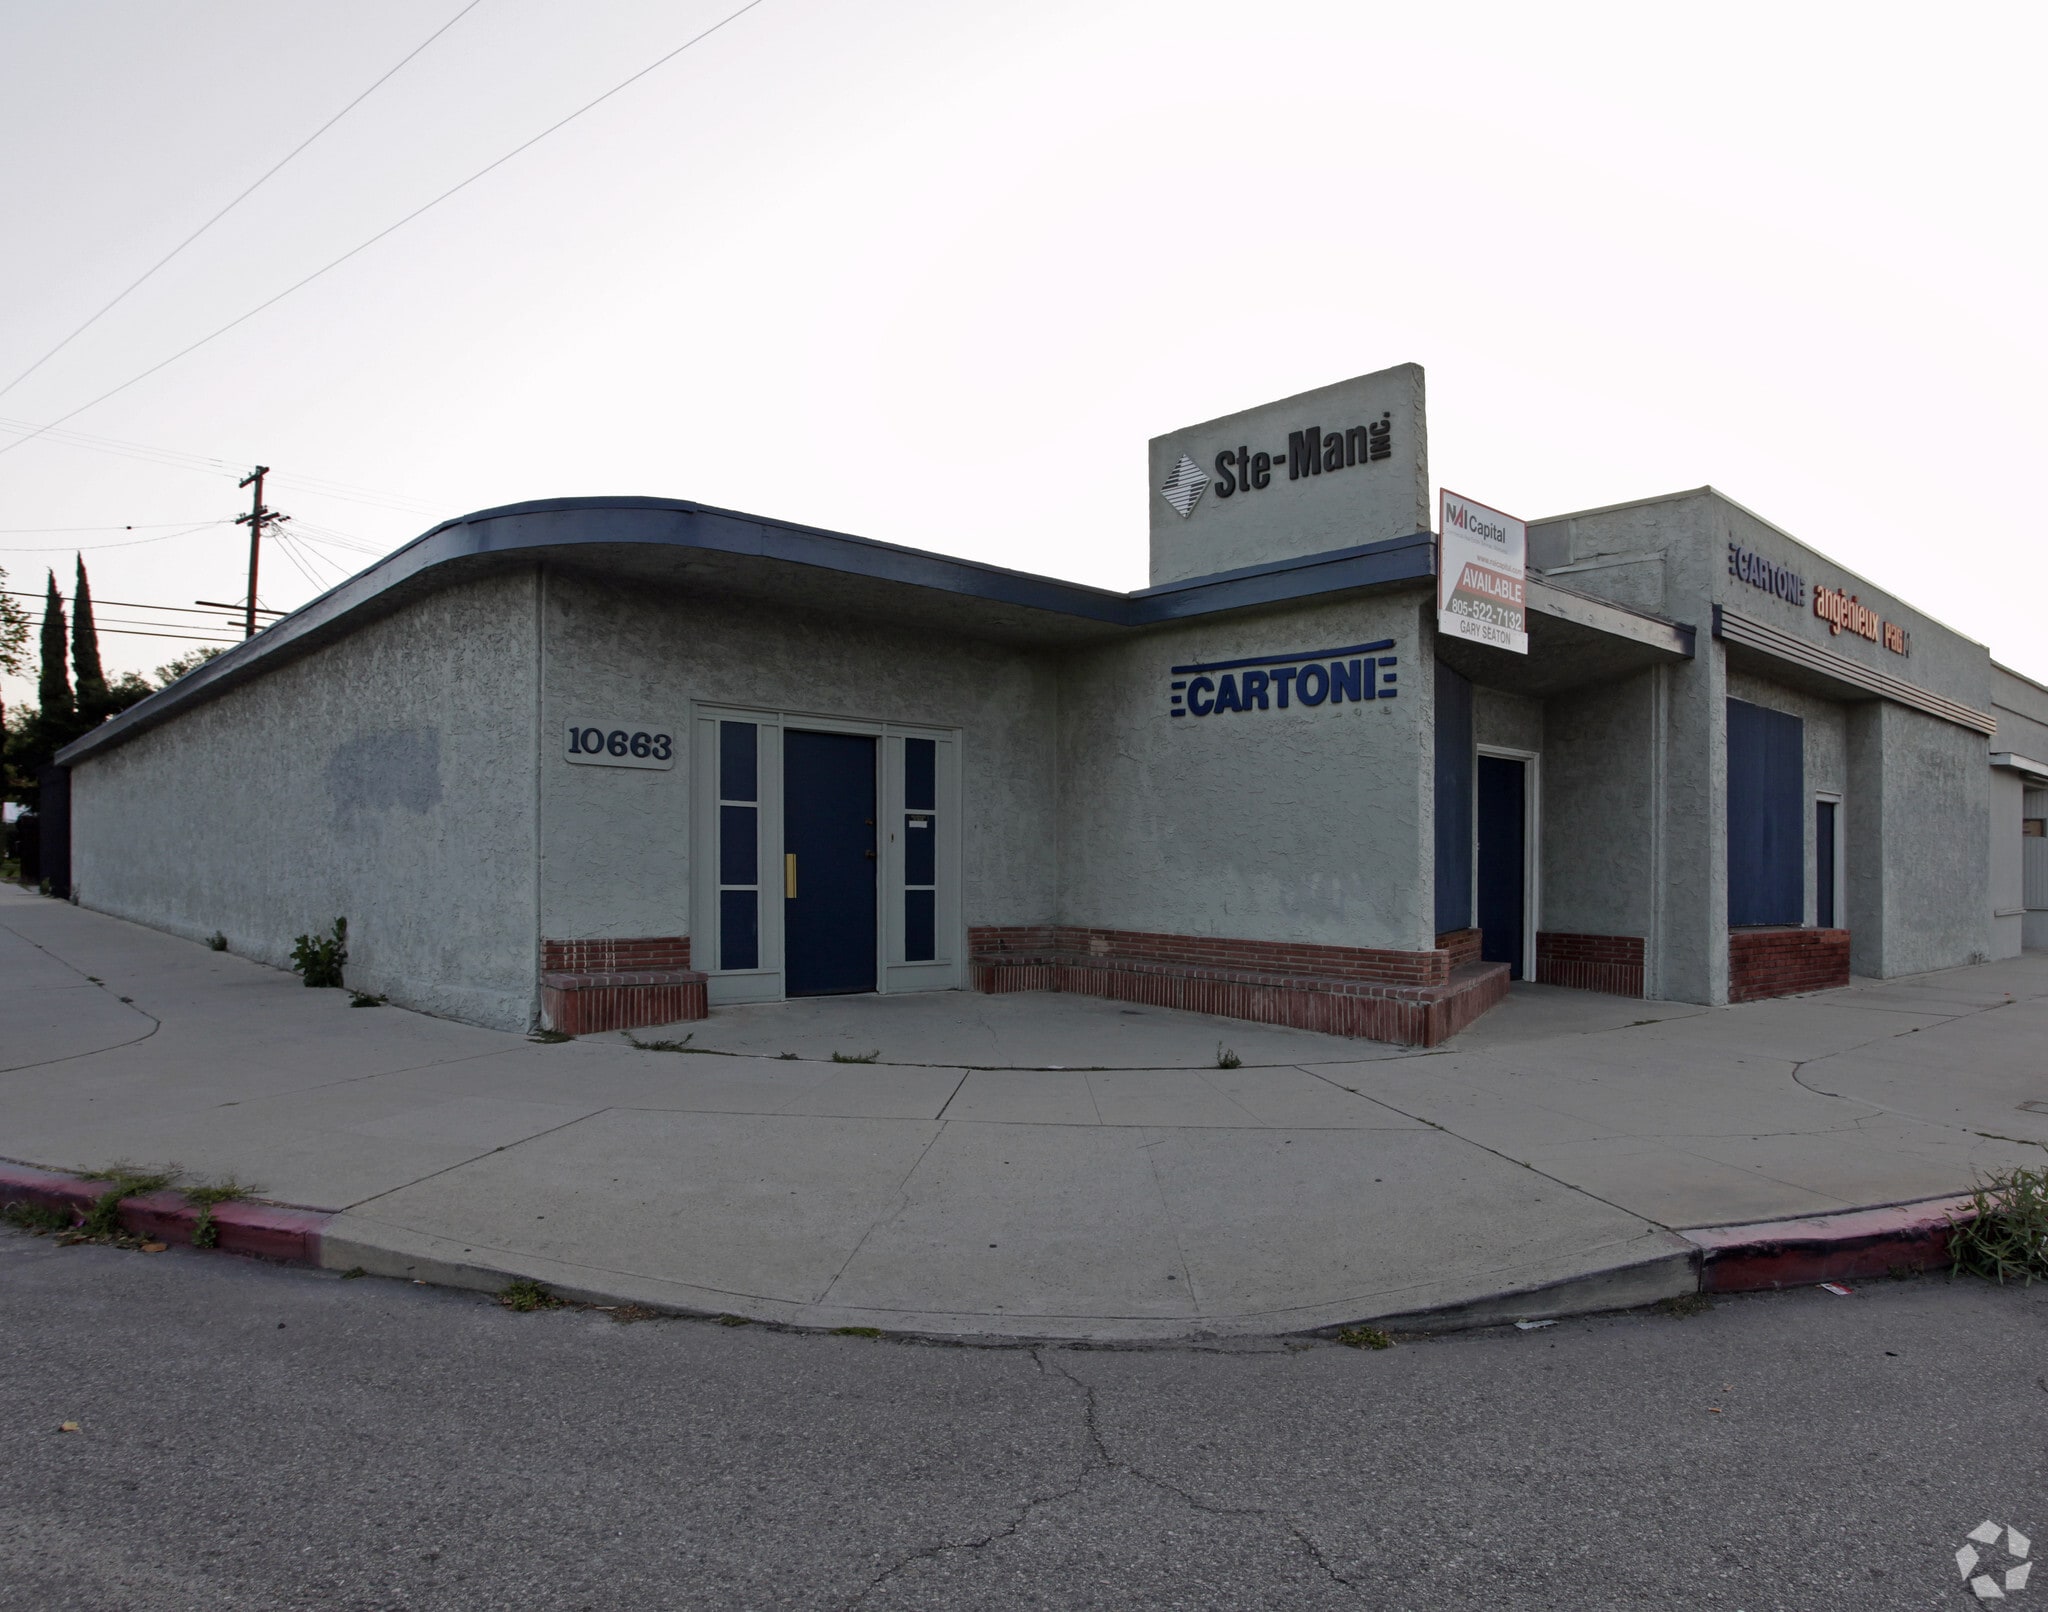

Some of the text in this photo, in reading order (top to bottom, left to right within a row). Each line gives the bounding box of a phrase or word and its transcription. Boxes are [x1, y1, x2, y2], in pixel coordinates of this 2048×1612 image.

[1369, 411, 1392, 461] INC.
[1214, 425, 1368, 498] Ste-Man
[1446, 502, 1468, 530] NAI
[1469, 515, 1506, 543] Capital
[1462, 567, 1522, 603] AVAILABLE
[1451, 598, 1522, 631] 805-522-7132
[1460, 619, 1512, 645] GARY SEATON
[1187, 657, 1376, 717] CARTONI
[567, 726, 673, 761] 10663
